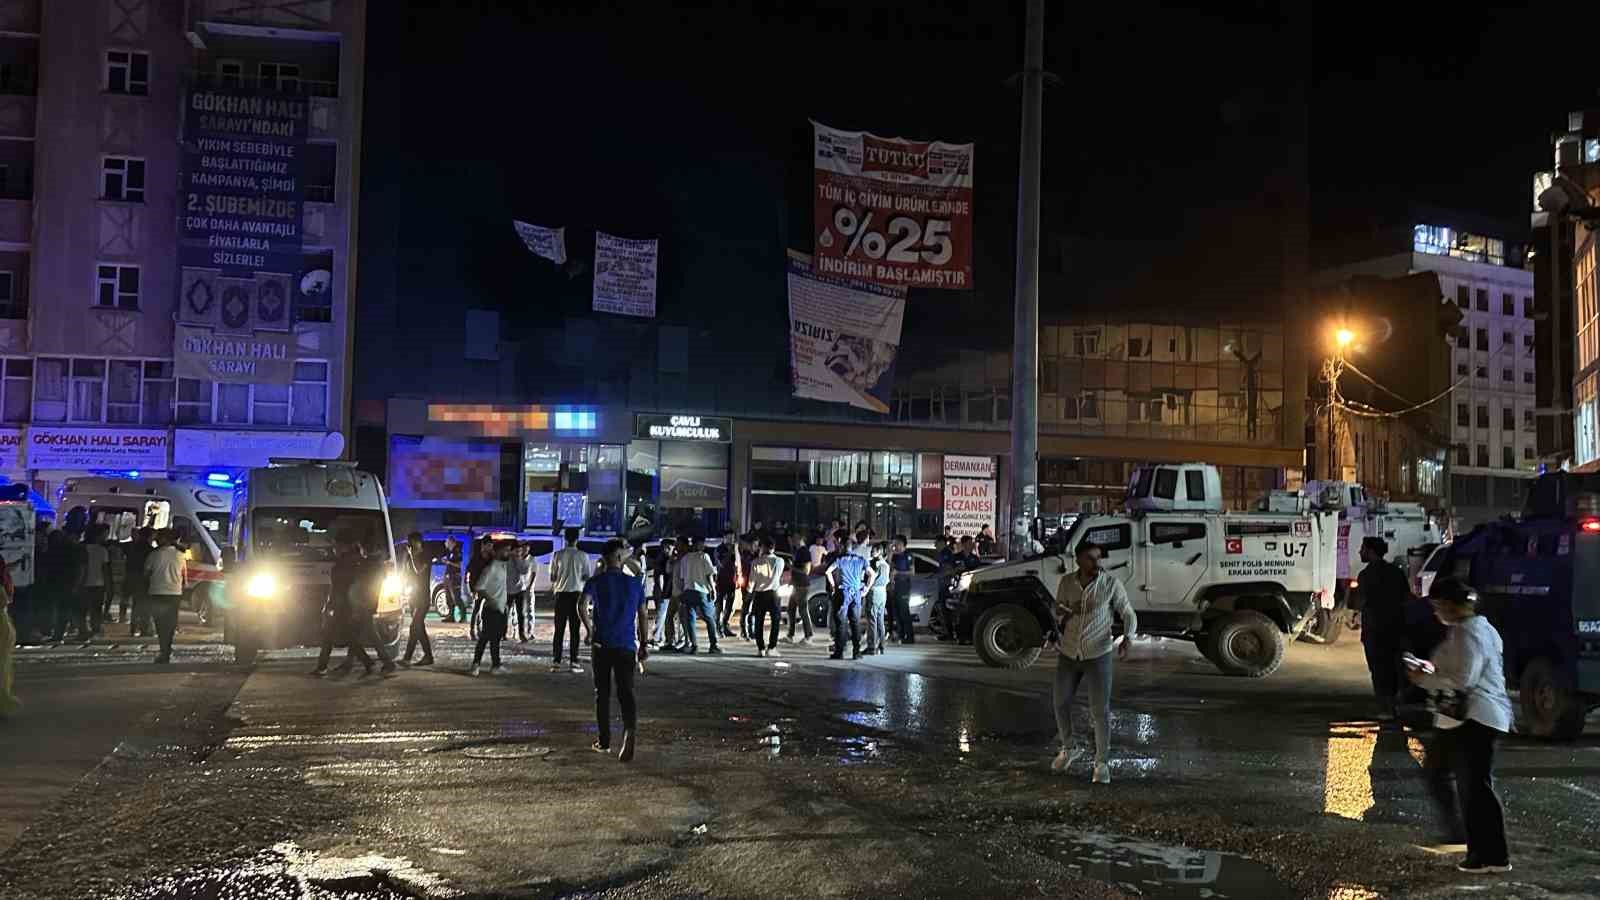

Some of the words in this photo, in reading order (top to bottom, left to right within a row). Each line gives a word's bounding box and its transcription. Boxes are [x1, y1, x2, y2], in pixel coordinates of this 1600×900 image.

[192, 92, 262, 115] GÖKHAN
[265, 96, 303, 119] HALI
[197, 136, 230, 152] YIKIM
[232, 140, 296, 158] SEBEBİYLE
[201, 155, 288, 174] BAŞLATTIĞIMIZ
[262, 175, 296, 192] ŞİMDİ
[187, 193, 203, 211] 2.
[205, 195, 296, 218] ŞUBEMİZDE
[818, 183, 841, 200] TÜM
[845, 184, 857, 205] İÇ
[895, 194, 969, 215] ÜRÜNLERİNDE
[186, 216, 208, 231] ÇOK
[210, 218, 239, 232] DAHA
[241, 220, 296, 237] AVANTAJLI
[209, 233, 270, 251] FİYATLARLA
[834, 207, 953, 265] %25
[819, 253, 872, 277] İNDİRİM
[876, 265, 965, 286] BAŞLAMIŞTIR
[184, 335, 246, 355] GÖKHAN
[252, 343, 287, 359] HALI
[208, 360, 256, 375] SARAYI
[670, 415, 701, 427] ÇAVLI
[33, 432, 87, 445] GÖKHAN
[91, 435, 120, 446] HALI
[123, 436, 167, 447] SARAYI
[649, 425, 720, 438] KUYUMCULUK
[951, 483, 988, 497] DİLAN
[945, 499, 992, 512] ECZANESİ
[1283, 543, 1308, 557] U-7
[1242, 559, 1262, 567] POLİS
[1265, 559, 1295, 567] MEMURU
[1228, 568, 1252, 576] ERKAN
